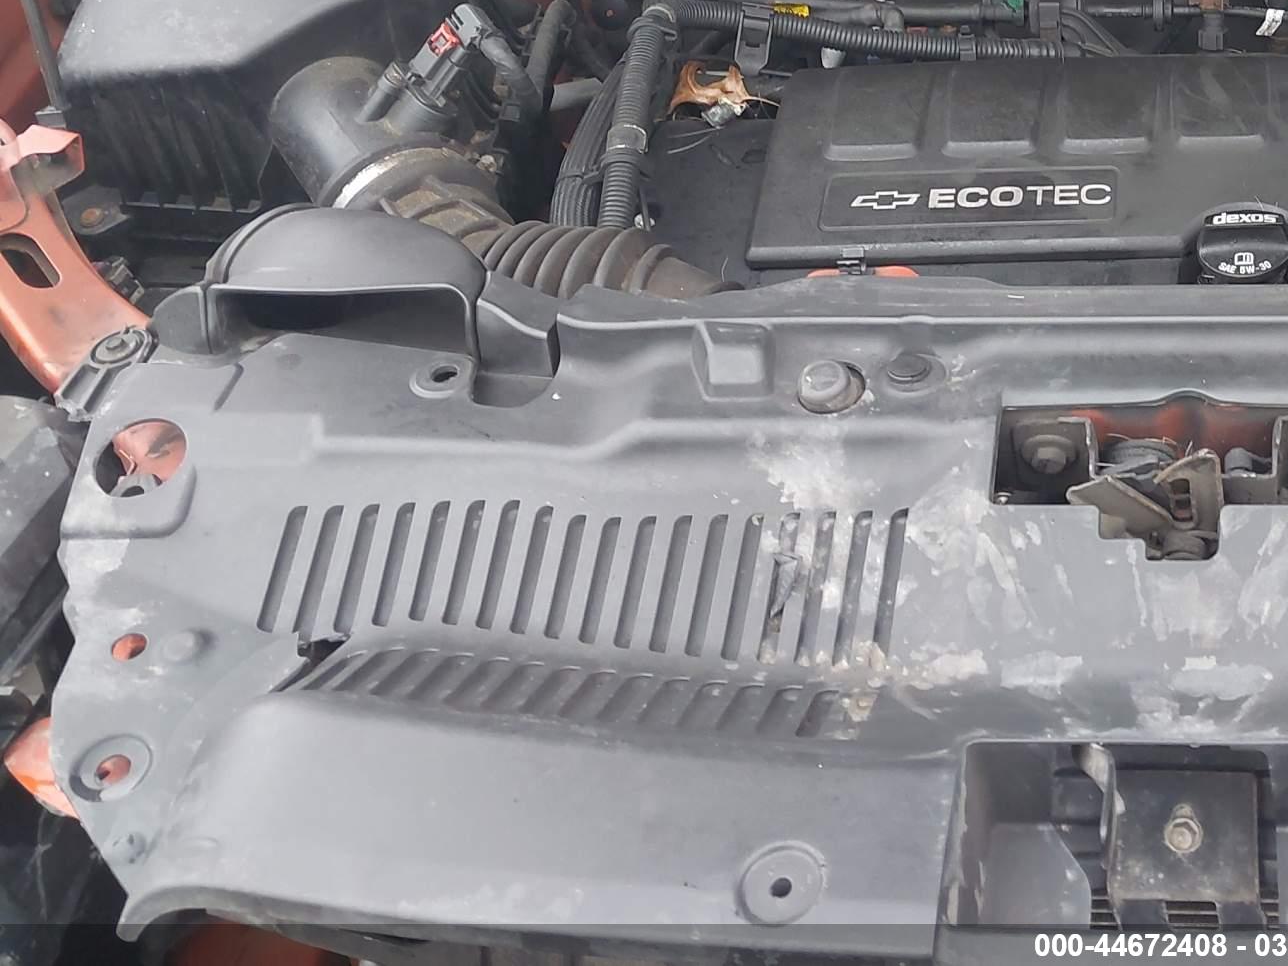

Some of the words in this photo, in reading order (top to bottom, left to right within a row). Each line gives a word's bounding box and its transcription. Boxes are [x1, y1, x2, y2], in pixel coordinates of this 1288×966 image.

[927, 184, 1112, 209] ECOTEC
[1212, 212, 1279, 225] dexos
[1218, 261, 1237, 274] SAE
[1239, 260, 1272, 275] 5W-30
